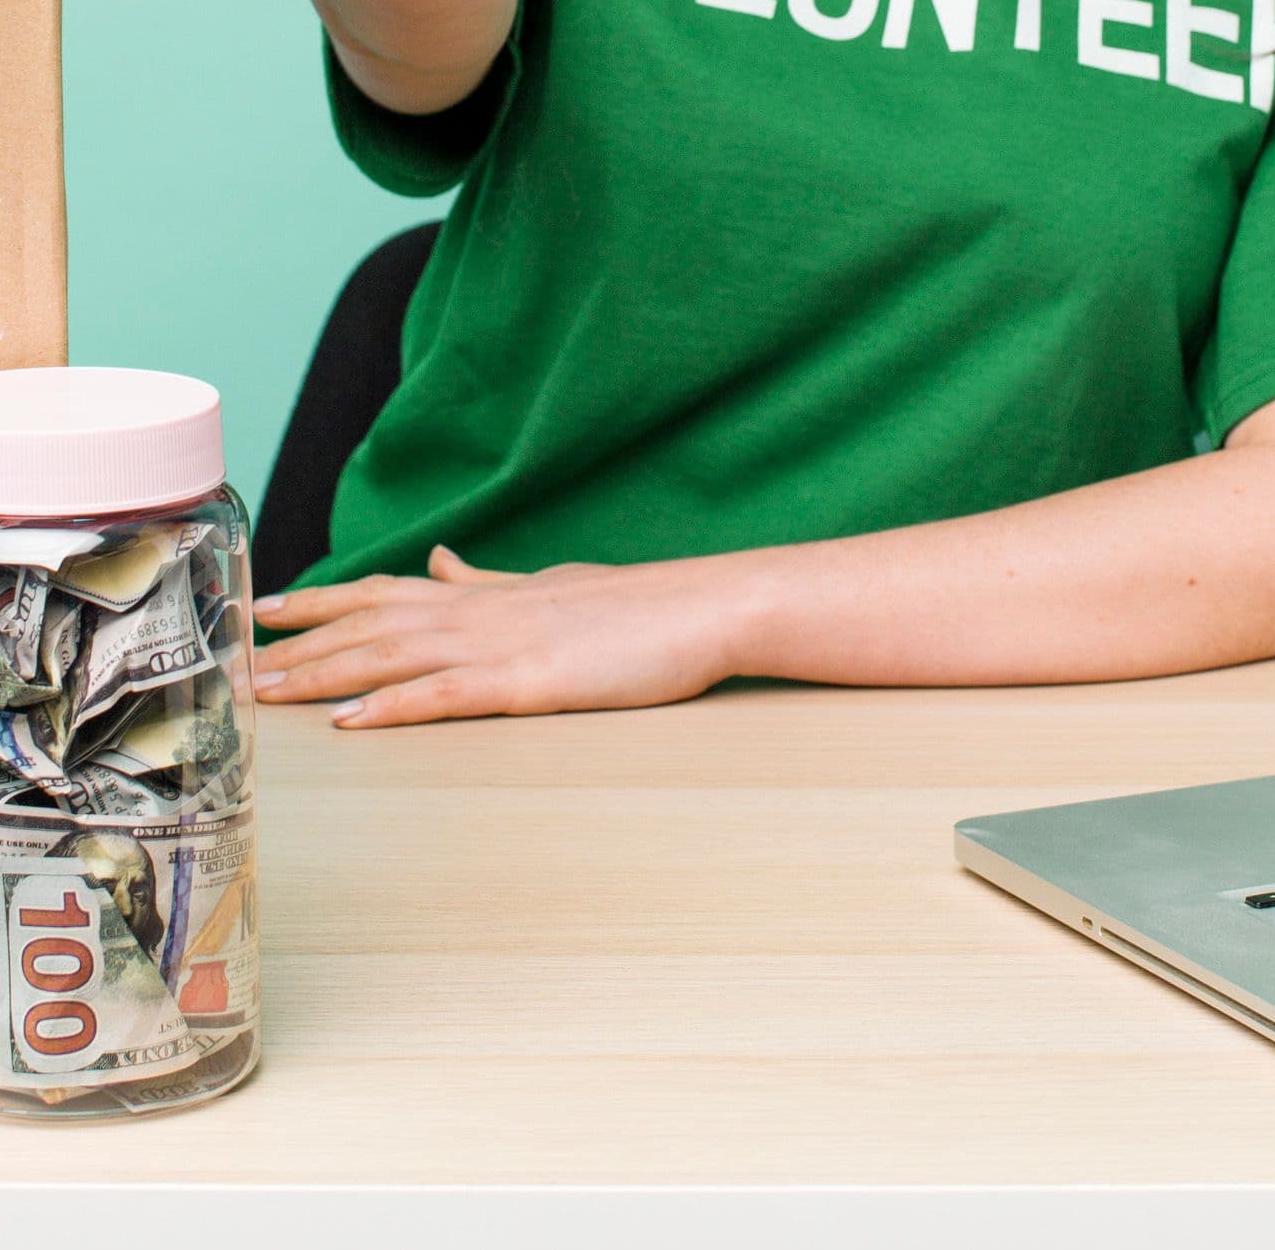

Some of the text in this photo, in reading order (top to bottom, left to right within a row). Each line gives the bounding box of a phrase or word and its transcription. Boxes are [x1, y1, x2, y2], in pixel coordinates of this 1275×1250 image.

[6, 839, 24, 848] USE
[26, 841, 50, 850] ONLY
[19, 891, 98, 1056] 100
